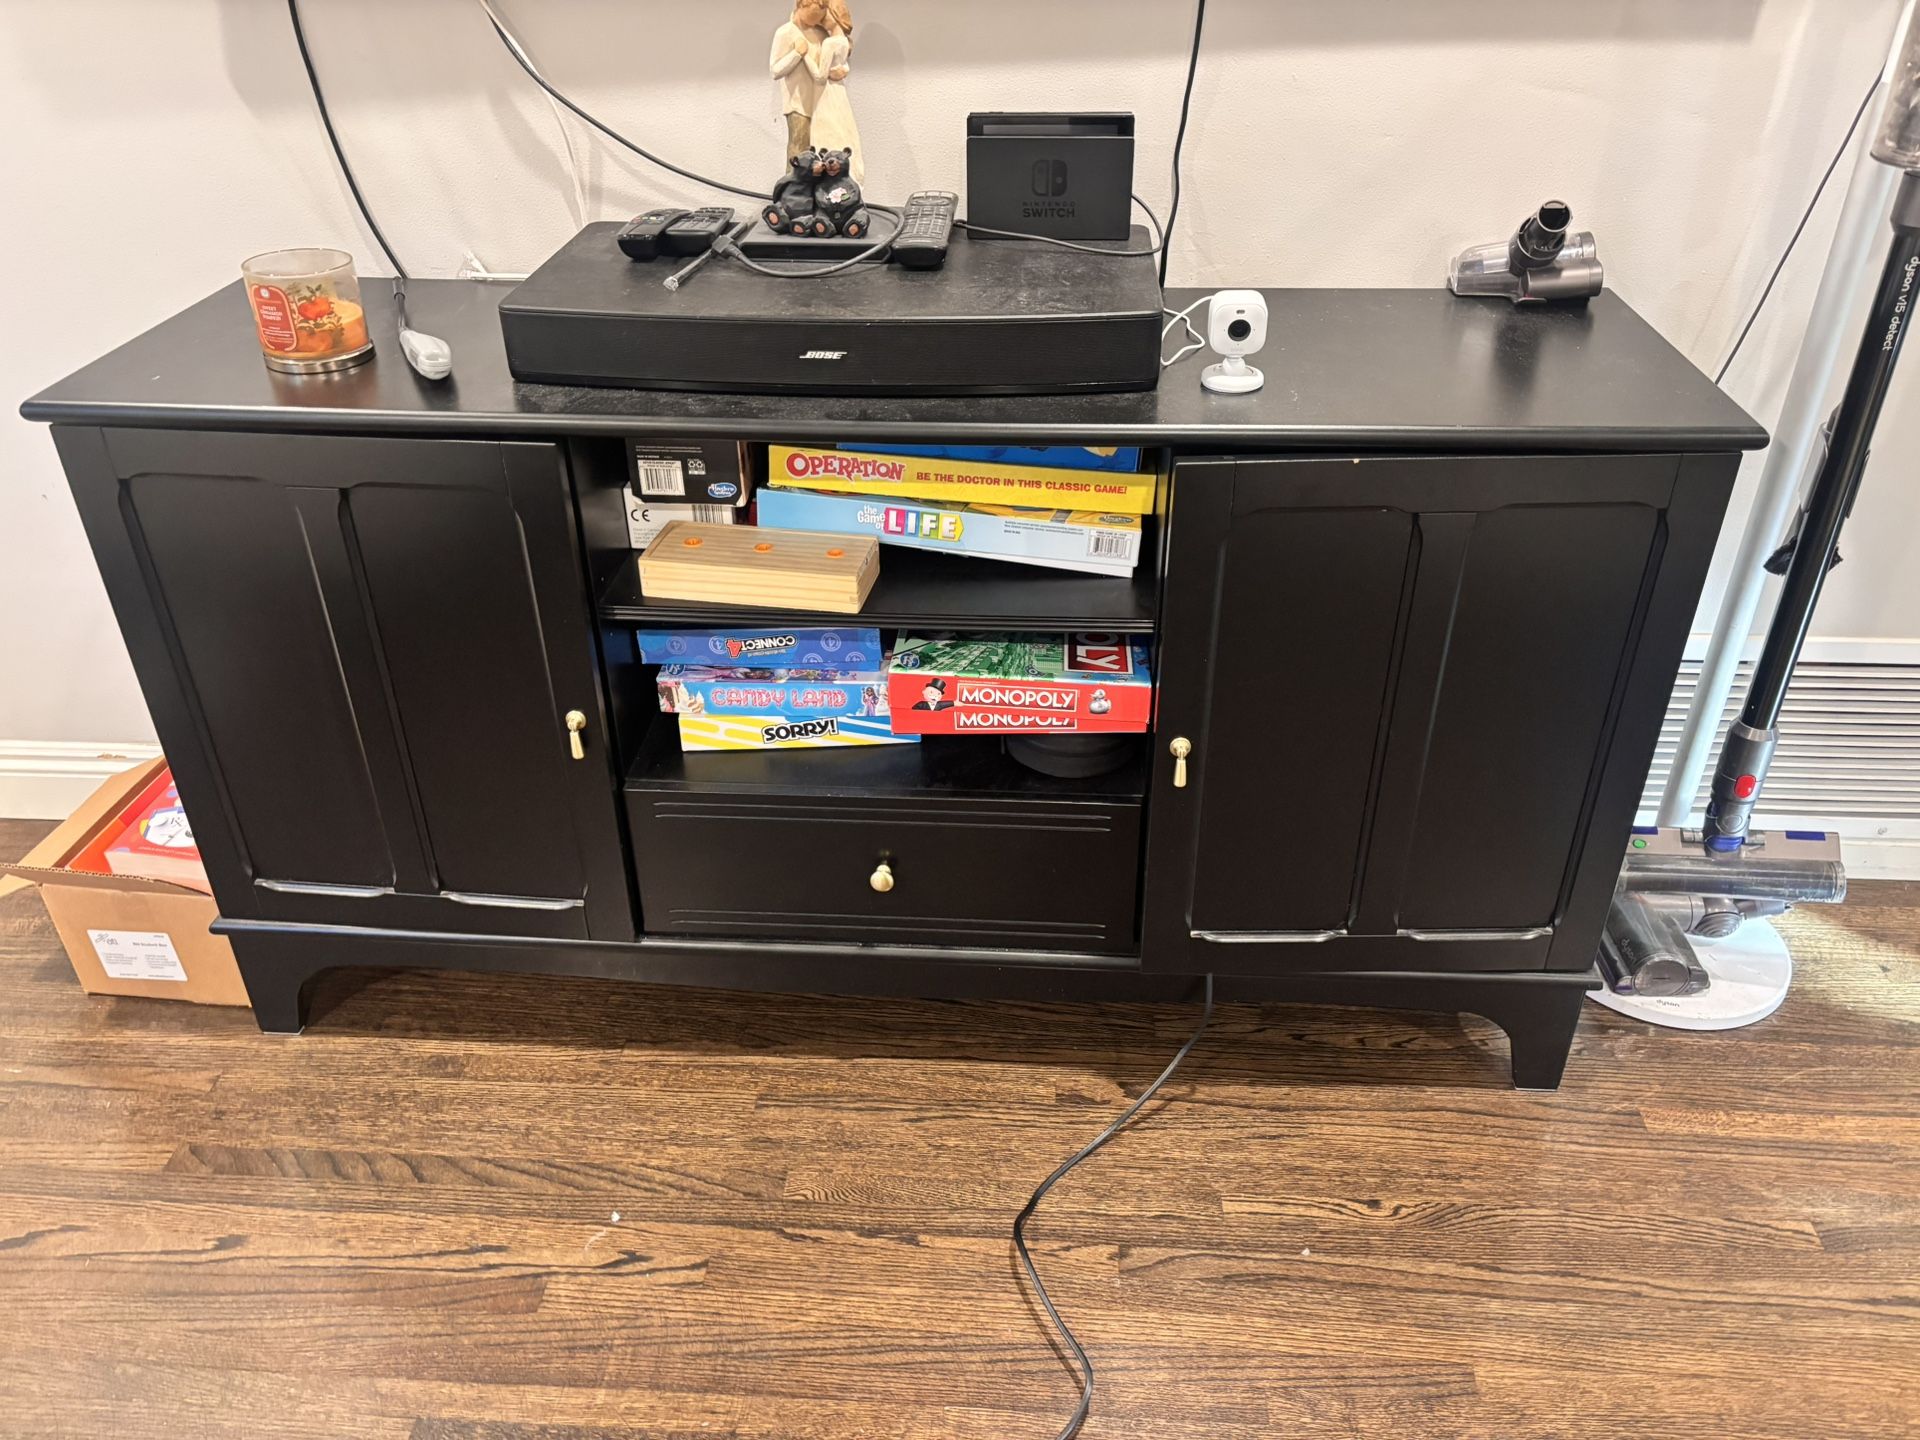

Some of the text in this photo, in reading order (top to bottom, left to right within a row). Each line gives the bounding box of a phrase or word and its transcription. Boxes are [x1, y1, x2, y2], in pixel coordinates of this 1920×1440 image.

[1022, 200, 1077, 208] NINTENDO
[1022, 207, 1076, 218] SWITCH
[1902, 256, 1920, 292] dyson
[1882, 316, 1901, 351] detect
[799, 351, 848, 360] BOSE
[785, 452, 1128, 494] OPERATION BE THE DOCTOR IN THIS CLASSIC GAME!
[631, 509, 651, 522] CE
[864, 505, 877, 515] the
[857, 509, 957, 539] Game LIFE
[726, 639, 742, 657] 4
[741, 635, 796, 651] CONNECT
[711, 688, 848, 708] CANDY LAND
[961, 687, 1075, 708] MONOPOLY
[763, 718, 837, 743] SORRY!
